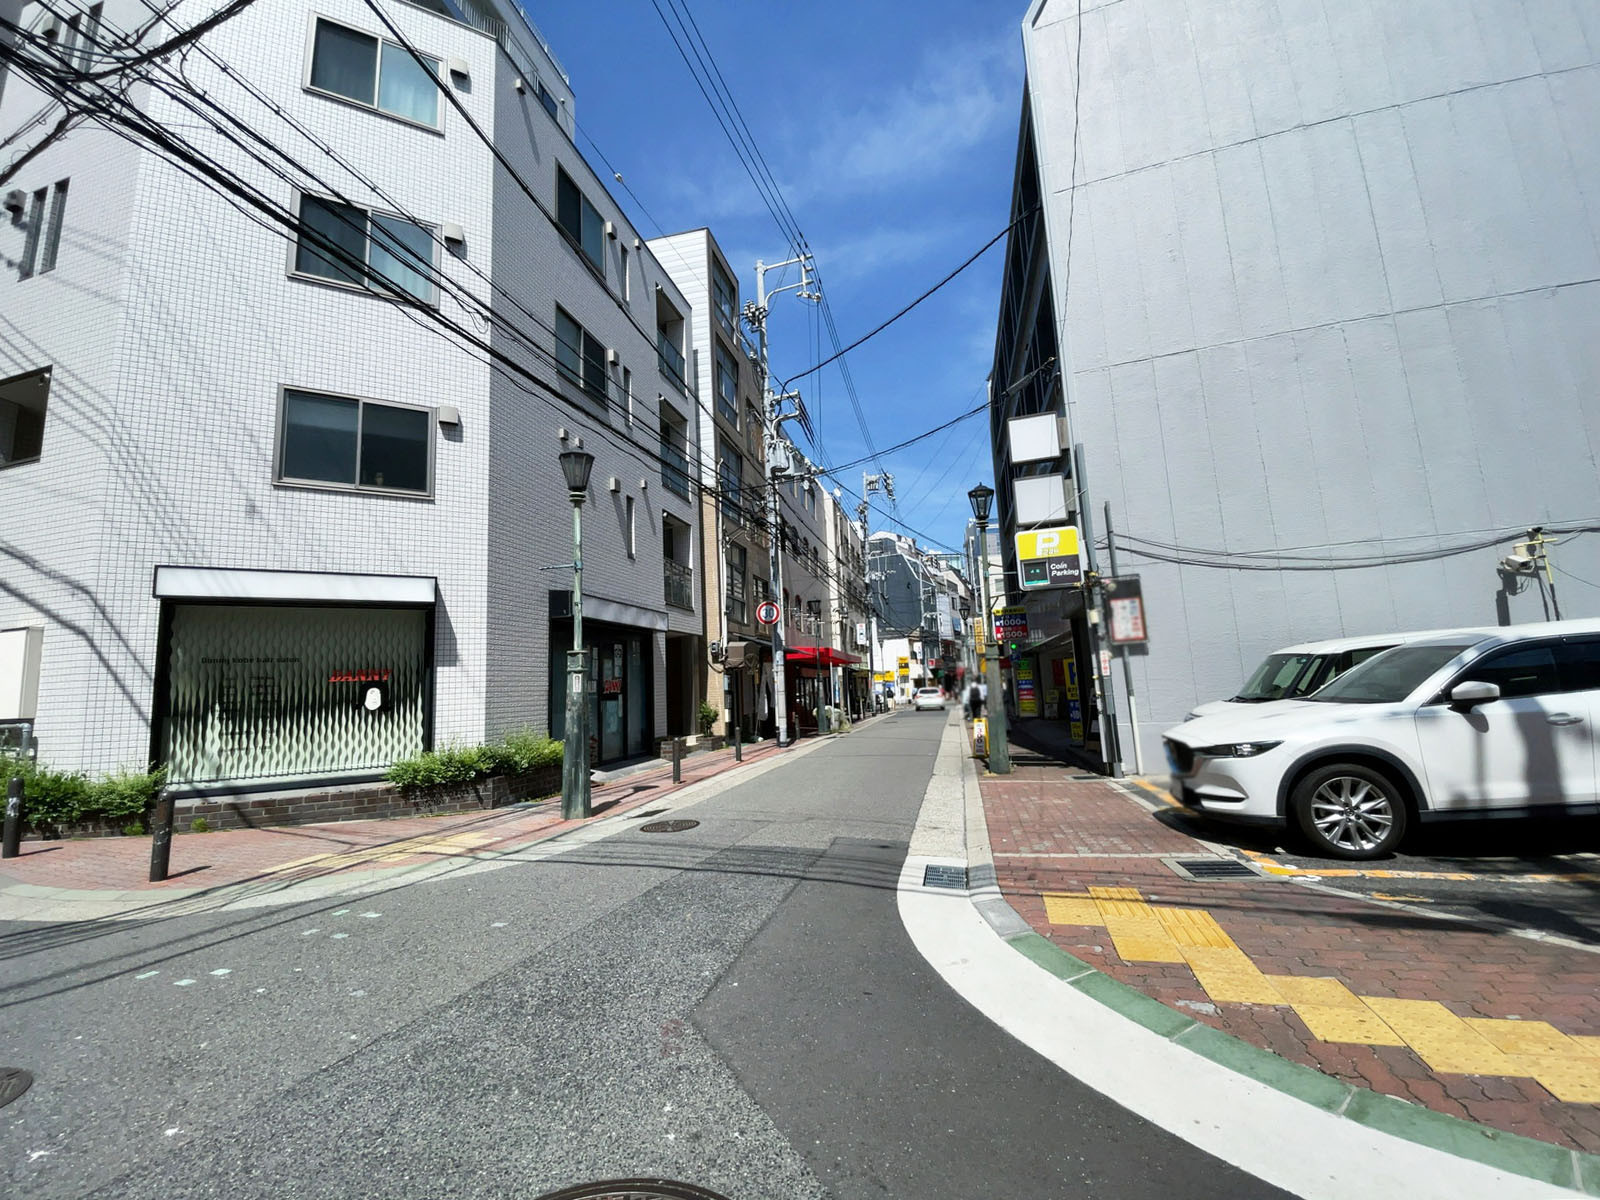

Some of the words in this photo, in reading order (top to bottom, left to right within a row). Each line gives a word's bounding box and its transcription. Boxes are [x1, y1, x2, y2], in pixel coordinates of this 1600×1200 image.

[1036, 532, 1060, 556] P
[1050, 561, 1068, 570] Coin
[1051, 569, 1080, 577] Parking
[762, 605, 775, 619] 30
